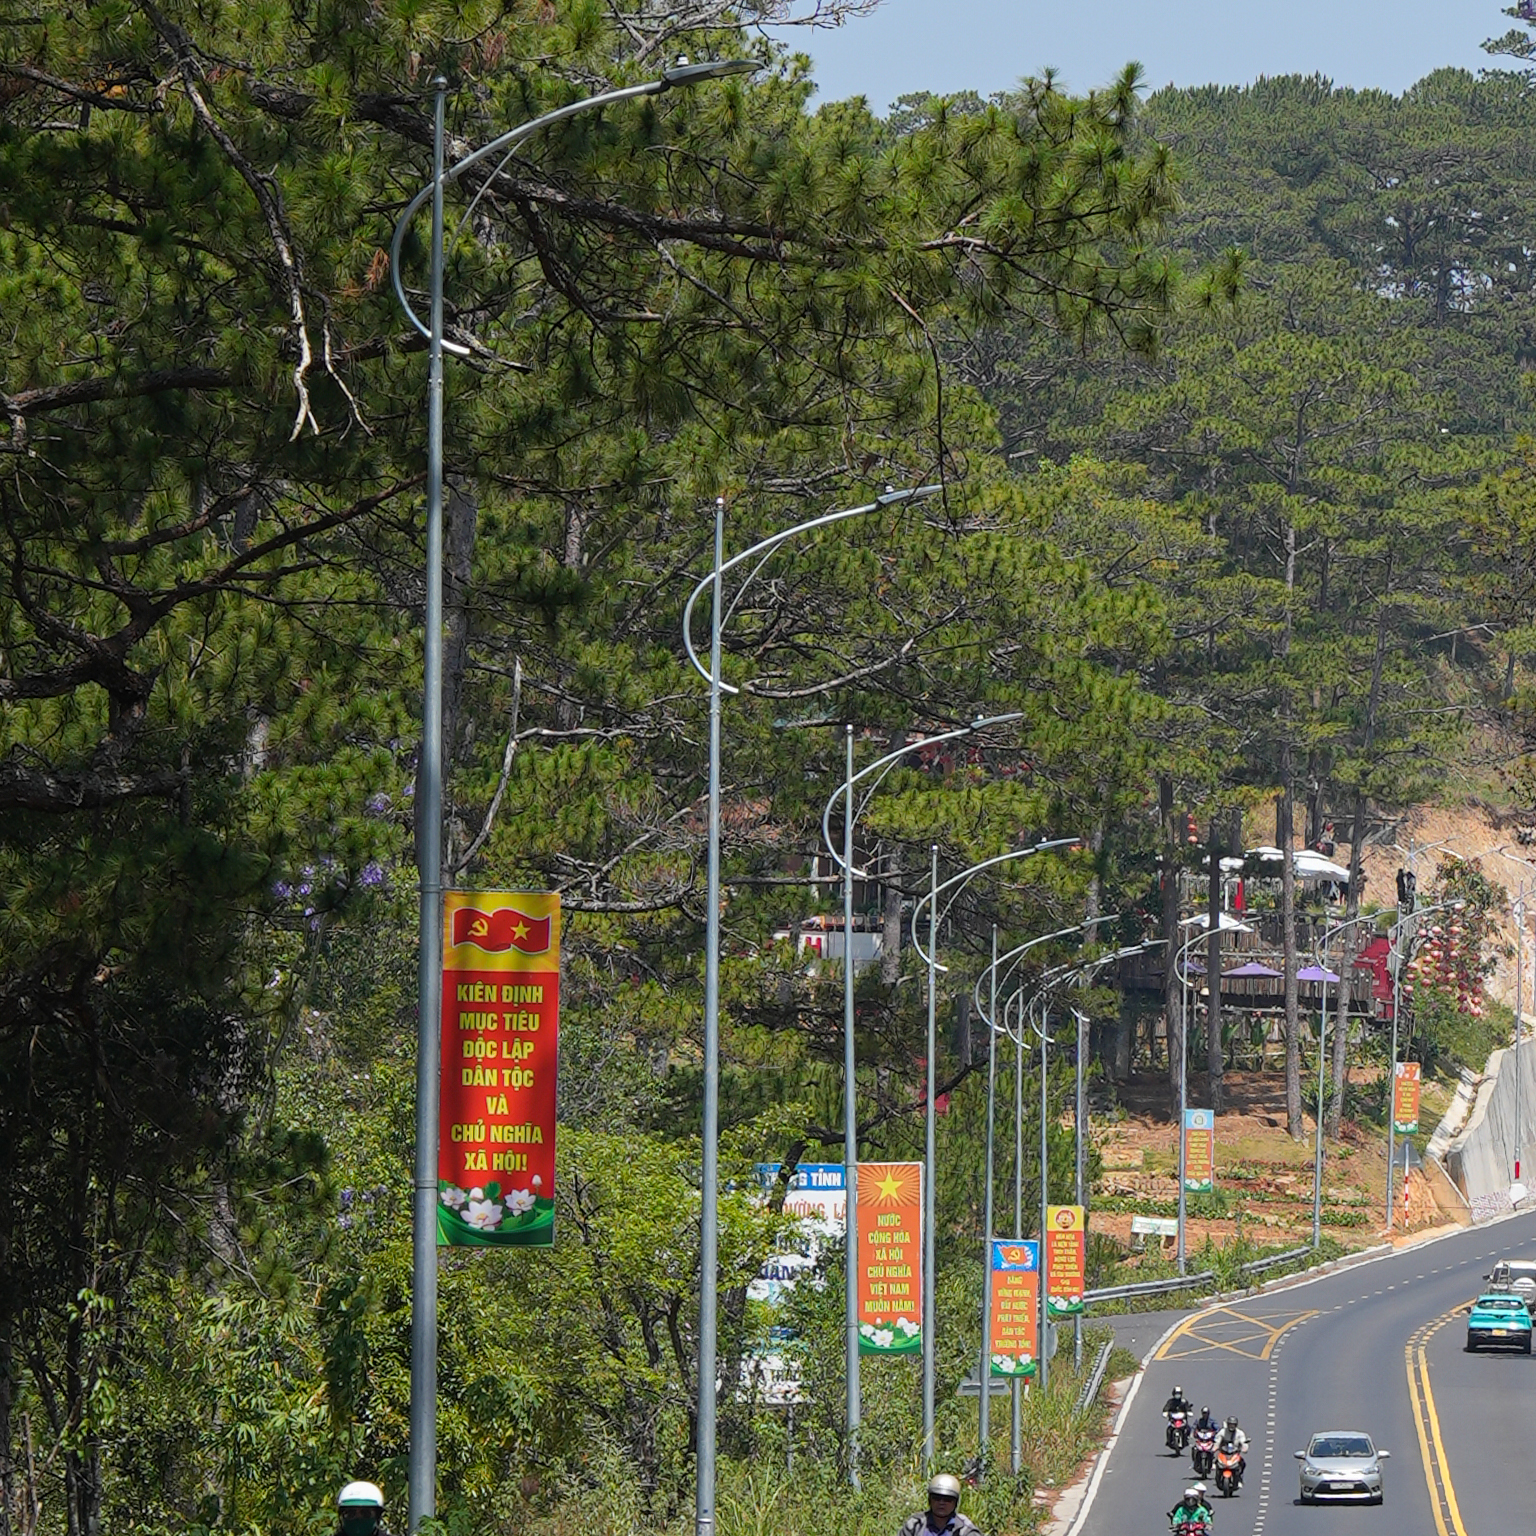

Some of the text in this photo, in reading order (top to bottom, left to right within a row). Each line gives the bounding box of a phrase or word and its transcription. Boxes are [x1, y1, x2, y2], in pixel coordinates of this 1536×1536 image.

[457, 980, 543, 1007] KIÊN ĐỊNH
[459, 1010, 540, 1034] MỤC TIÊU
[462, 1037, 535, 1063] ĐỘC LẬP
[461, 1064, 534, 1091] DÂN TỘC
[485, 1093, 509, 1115] VÀ
[451, 1118, 543, 1144] CHỦ NGHĨA
[464, 1149, 528, 1175] XÃ HỘI!
[869, 1281, 910, 1297] VIỆT NAM
